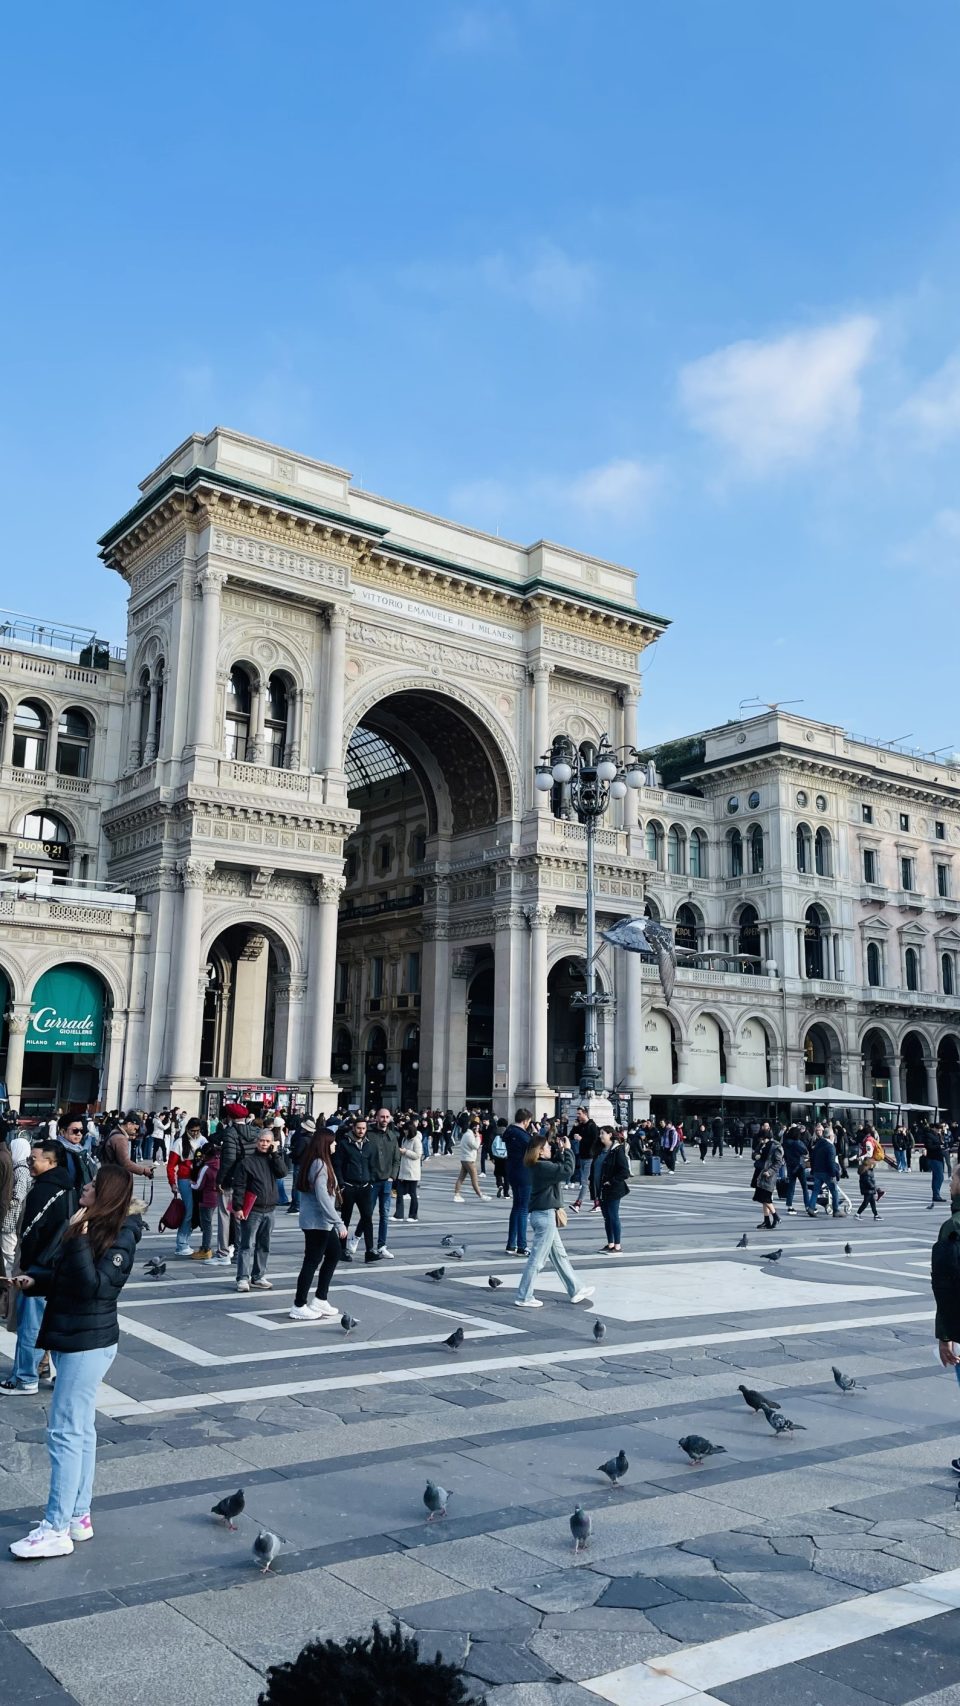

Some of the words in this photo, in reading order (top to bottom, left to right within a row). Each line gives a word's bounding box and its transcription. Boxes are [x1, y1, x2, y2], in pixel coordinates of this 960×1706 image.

[362, 591, 403, 610] VITTORIO
[407, 604, 453, 624] EMANUELE
[457, 618, 464, 627] II
[479, 624, 514, 641] MILANESI
[18, 841, 51, 853] DUOMO
[52, 845, 62, 854] 21
[32, 1006, 94, 1033] Currado
